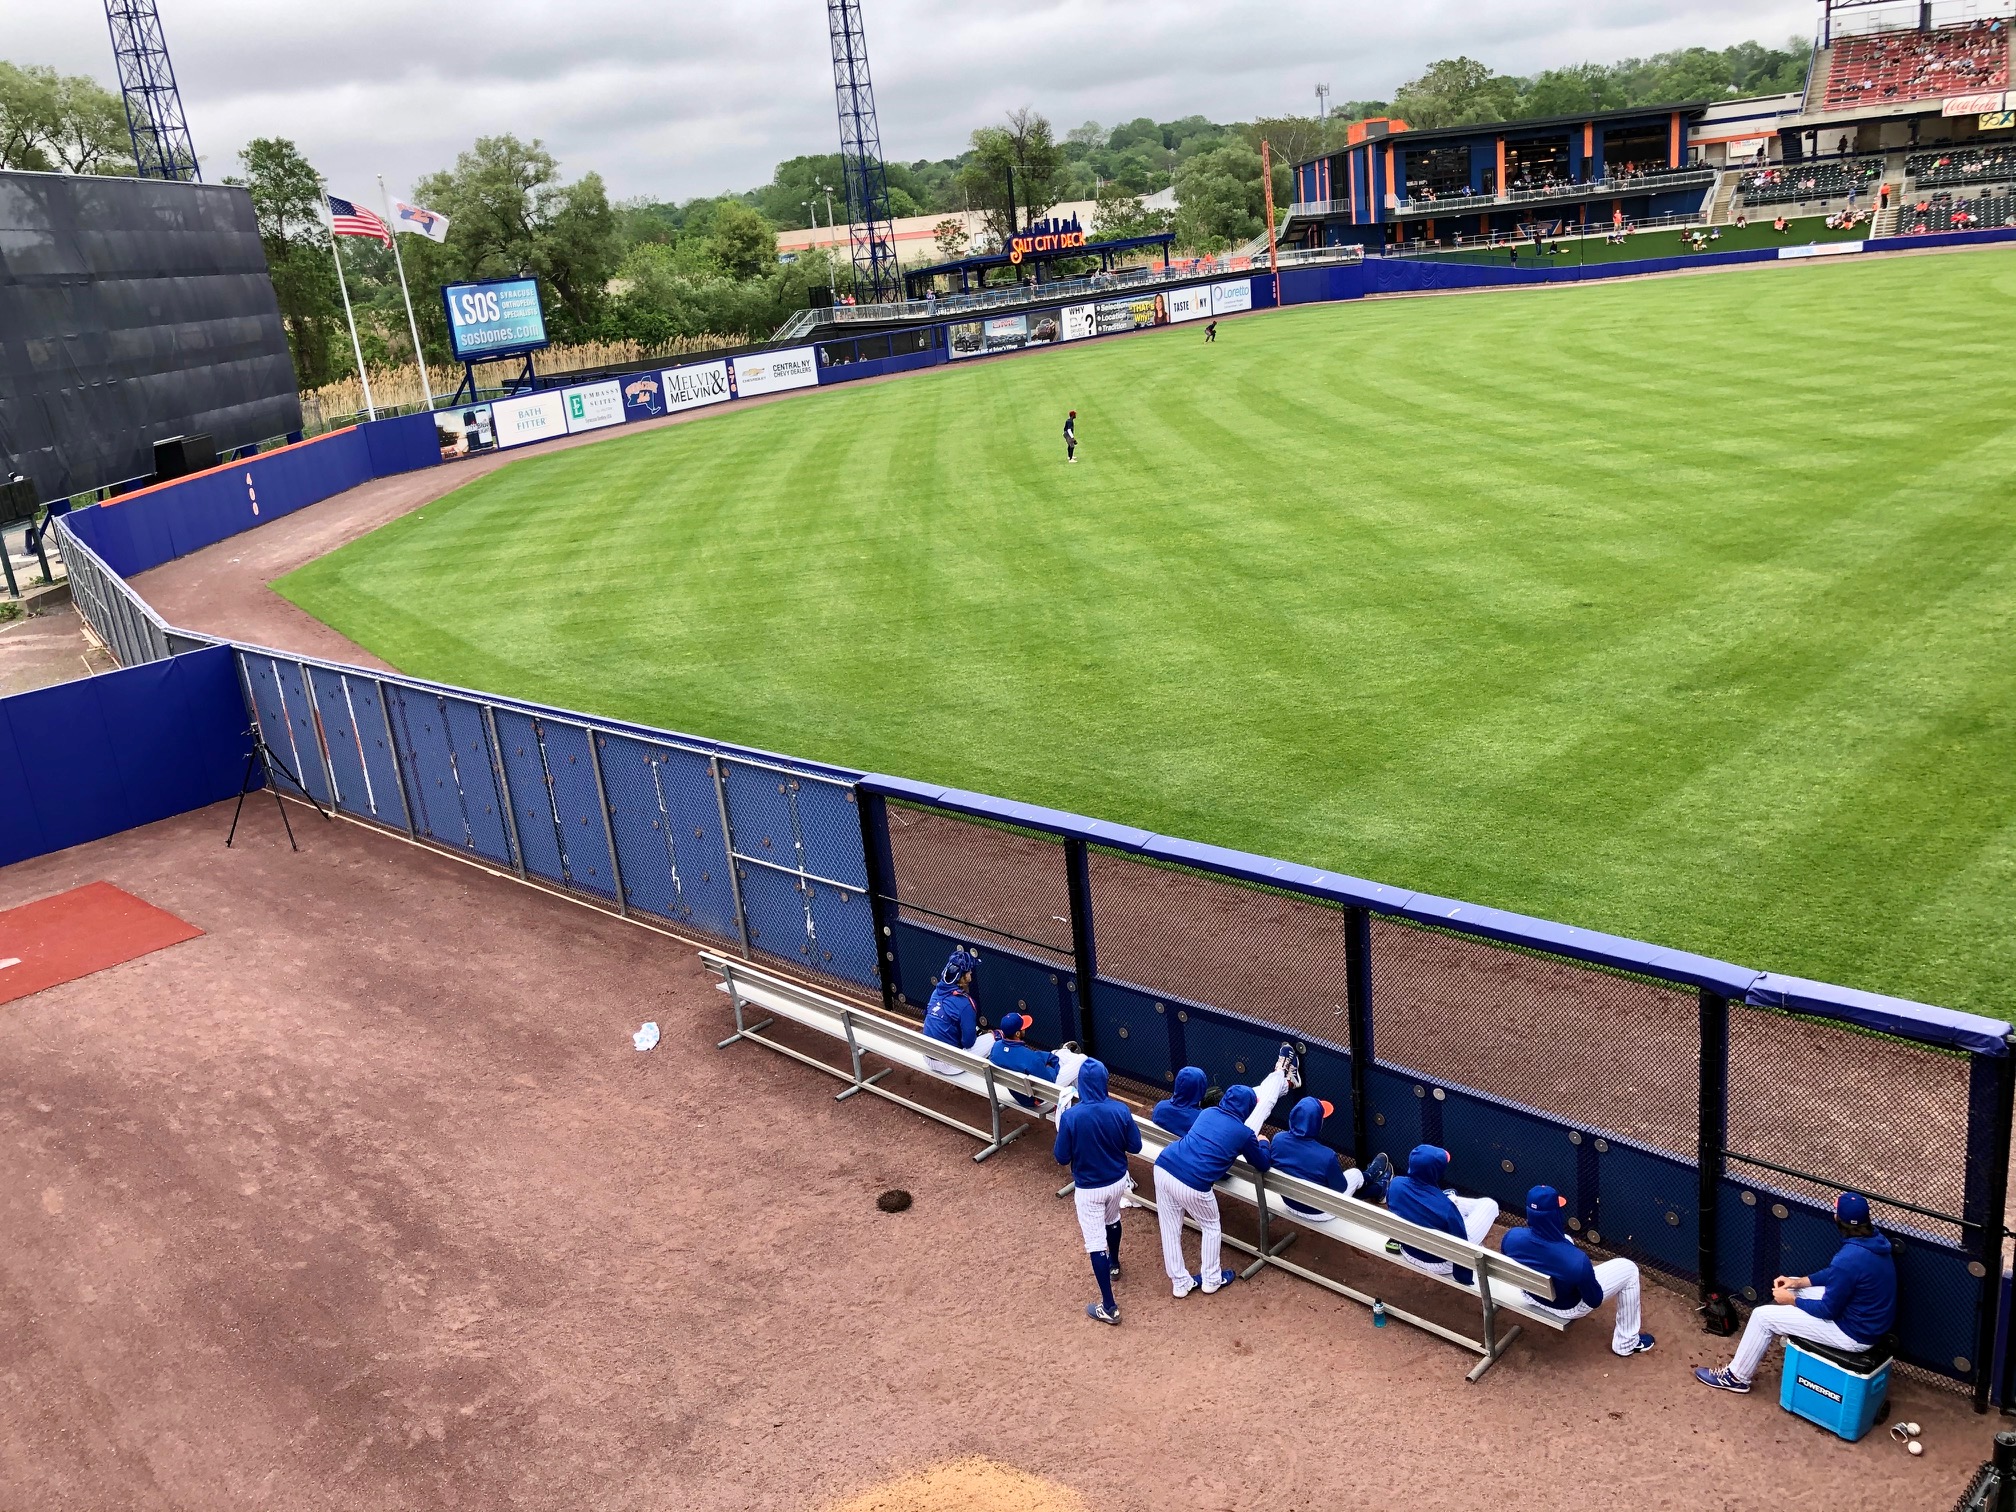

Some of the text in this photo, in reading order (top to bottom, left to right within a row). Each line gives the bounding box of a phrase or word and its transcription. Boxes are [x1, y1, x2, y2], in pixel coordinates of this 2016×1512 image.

[1980, 111, 2013, 127] 95X
[1010, 231, 1087, 264] SALT CITY DECK
[499, 288, 535, 300] SYRACUSE
[1223, 285, 1250, 299] Loretto
[461, 291, 500, 325] SOS
[501, 299, 537, 309] ORTHOPEDIC
[1068, 305, 1085, 315] WHY
[1100, 301, 1128, 311] Selection
[1173, 298, 1207, 312] TASTE NY
[503, 308, 538, 319] SPECIALISTS
[1101, 311, 1127, 322] Location
[1102, 322, 1127, 332] Tradition
[460, 325, 539, 346] sosbones.com
[772, 359, 811, 371] CENTRAL NY
[773, 367, 812, 378] CHEVY DEALERS
[667, 371, 714, 393] MELVIN
[712, 369, 728, 395] &
[583, 388, 619, 399] EMBASSY
[670, 385, 711, 404] MELVIN
[589, 397, 617, 406] SUITES
[518, 407, 542, 418] BATH
[516, 417, 547, 430] FITTER
[246, 472, 259, 516] 400
[1798, 1376, 1842, 1402] POWERADE
